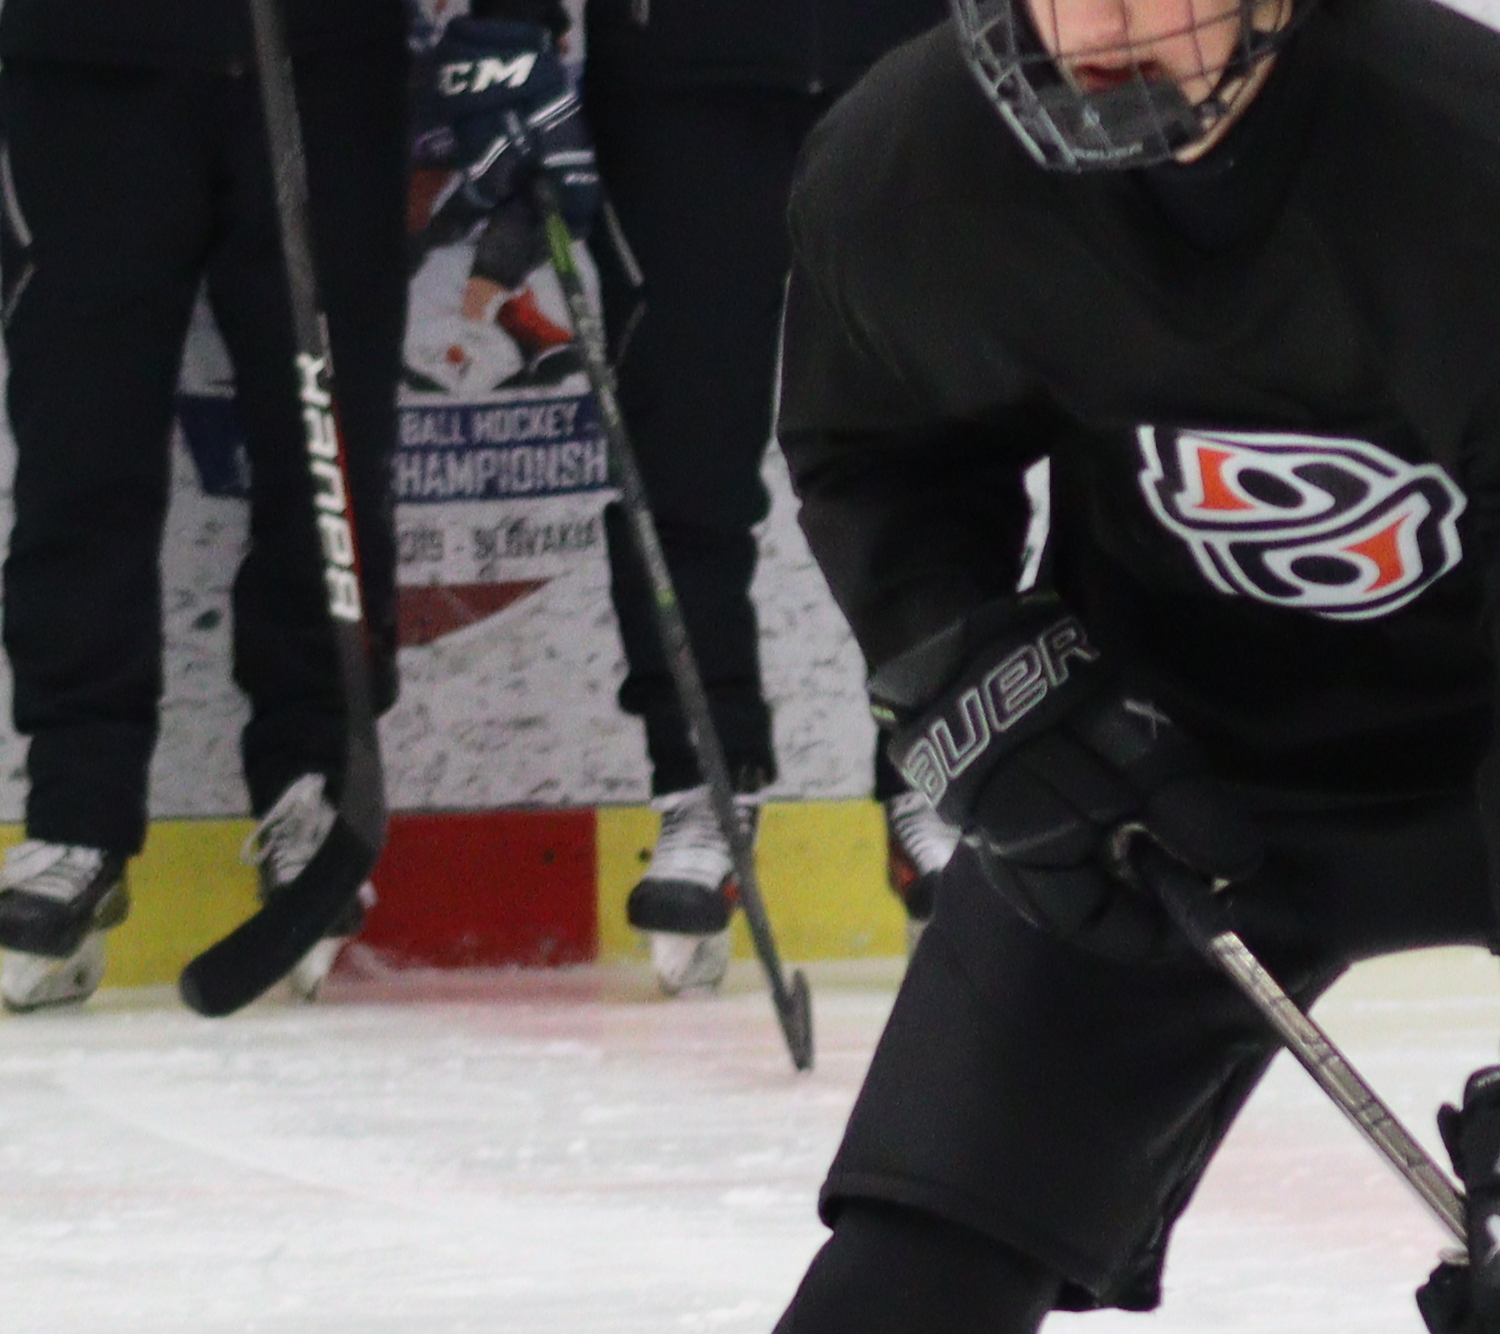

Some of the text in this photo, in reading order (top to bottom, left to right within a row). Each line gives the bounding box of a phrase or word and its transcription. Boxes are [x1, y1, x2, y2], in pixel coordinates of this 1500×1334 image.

[440, 52, 538, 95] CM
[472, 403, 580, 444] HOCKEY
[390, 437, 608, 498] HAMPIONSH
[902, 617, 1099, 809] AUER
